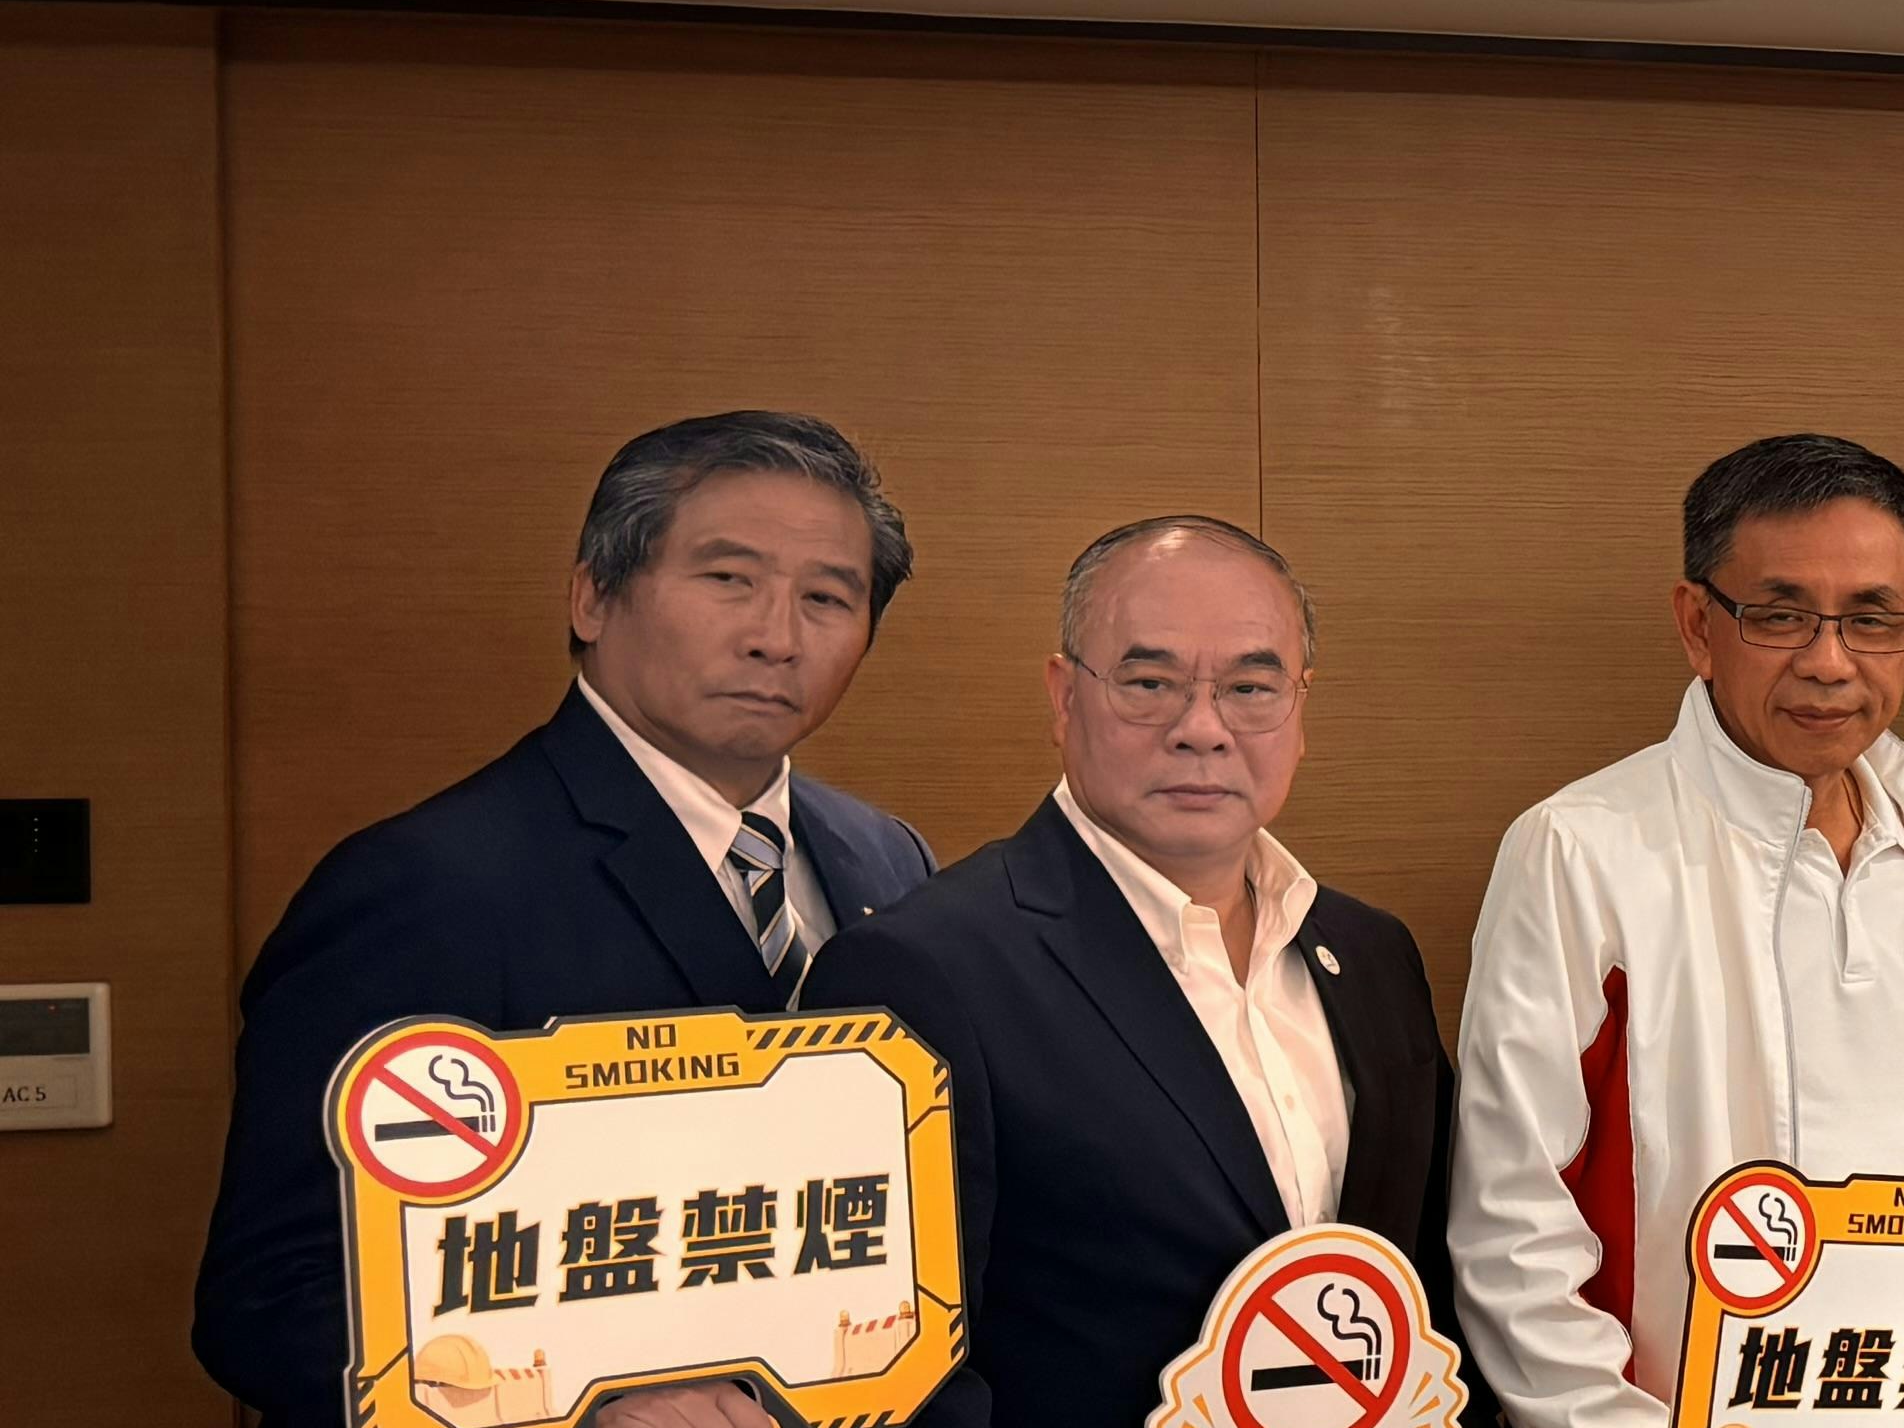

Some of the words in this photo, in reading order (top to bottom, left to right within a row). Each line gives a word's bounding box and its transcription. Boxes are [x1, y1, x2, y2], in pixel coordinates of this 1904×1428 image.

[626, 1024, 676, 1050] NO
[564, 1053, 740, 1089] SMOKING
[2, 1086, 30, 1103] AC
[35, 1085, 47, 1102] 5
[430, 1172, 891, 1319] 地盤禁煙
